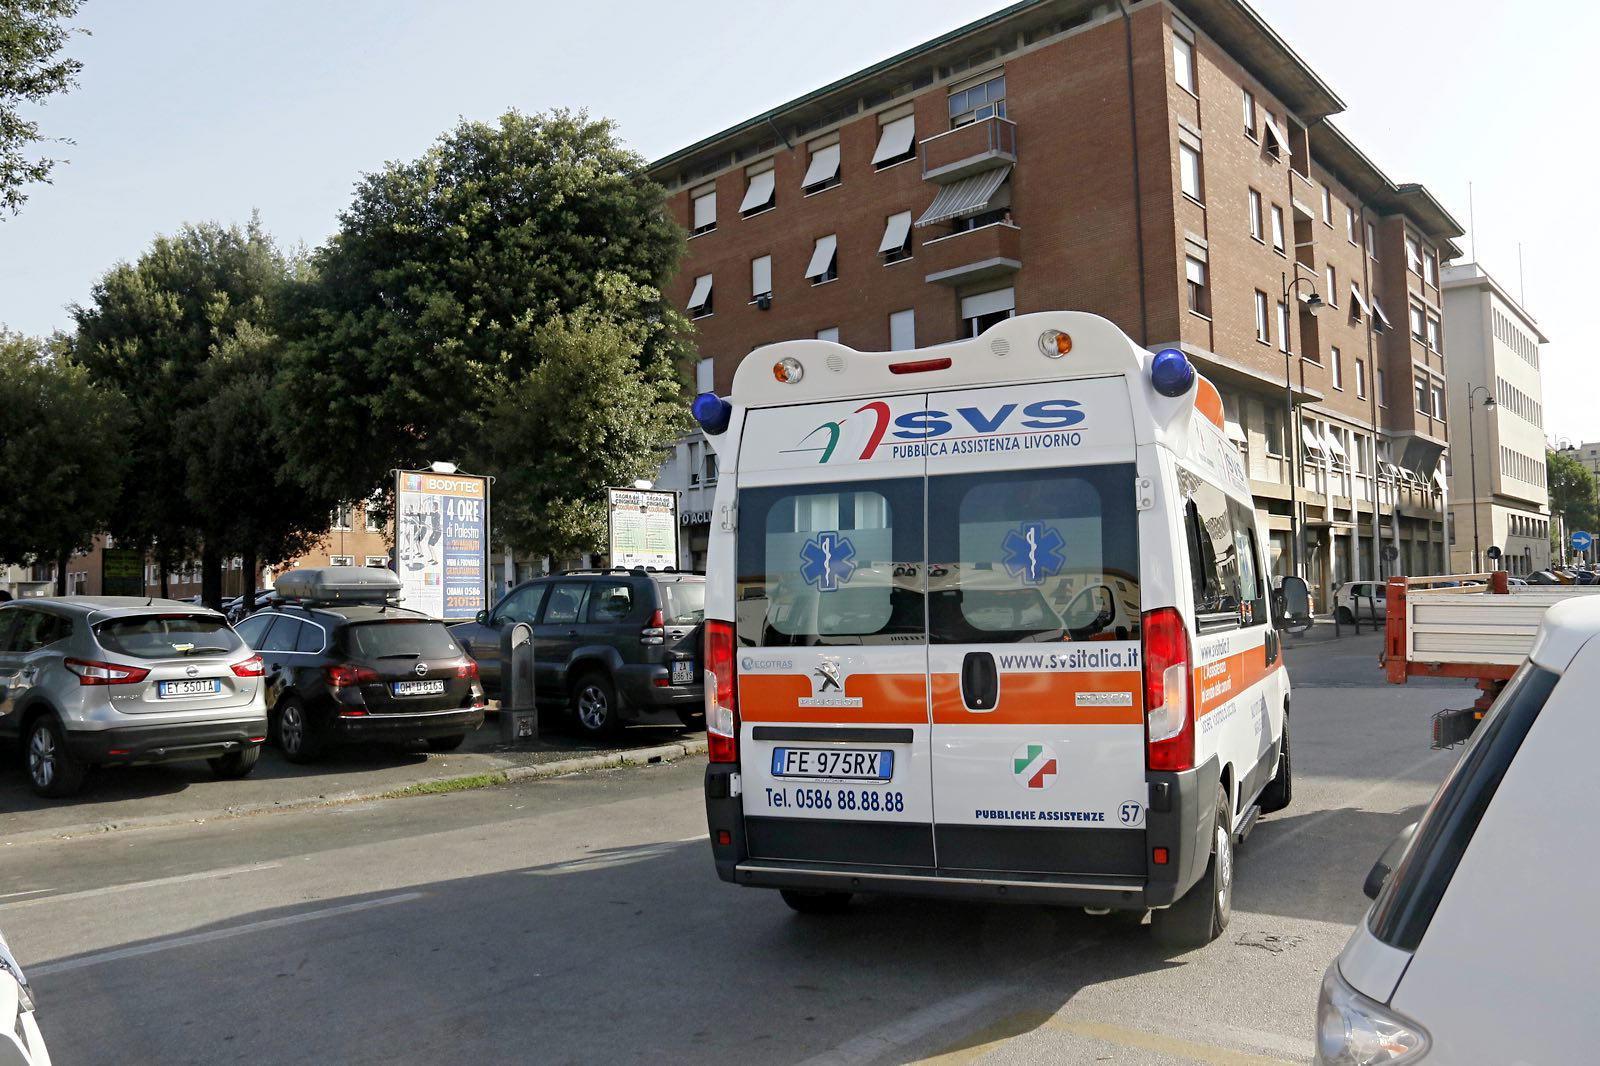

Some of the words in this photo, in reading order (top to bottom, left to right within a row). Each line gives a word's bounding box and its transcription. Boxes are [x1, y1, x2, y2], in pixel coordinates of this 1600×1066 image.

[892, 399, 1086, 439] SVS
[893, 441, 948, 459] PUBBLICA
[951, 437, 1020, 454] ASSISTENZA
[1024, 432, 1081, 449] LIVORNO
[429, 479, 479, 493] BODYTEC
[447, 499, 454, 520] 4
[457, 499, 479, 522] ORE
[446, 522, 453, 538] di
[454, 523, 479, 539] Palestra
[464, 587, 481, 596] 0586
[446, 596, 480, 607] 210131
[754, 660, 793, 669] ECOTRAS
[999, 648, 1138, 669] www.svsitalia.it
[167, 682, 179, 694] EY
[184, 680, 214, 692] 350TA
[786, 751, 810, 773] FE
[817, 752, 878, 775] 975RX
[765, 787, 792, 808] Tel.
[796, 788, 832, 810] 0586
[837, 790, 904, 813] 88.88.88
[975, 809, 1036, 820] PUBBLICHE
[1038, 810, 1105, 822] ASSISTENZE
[1121, 805, 1140, 822] 57
